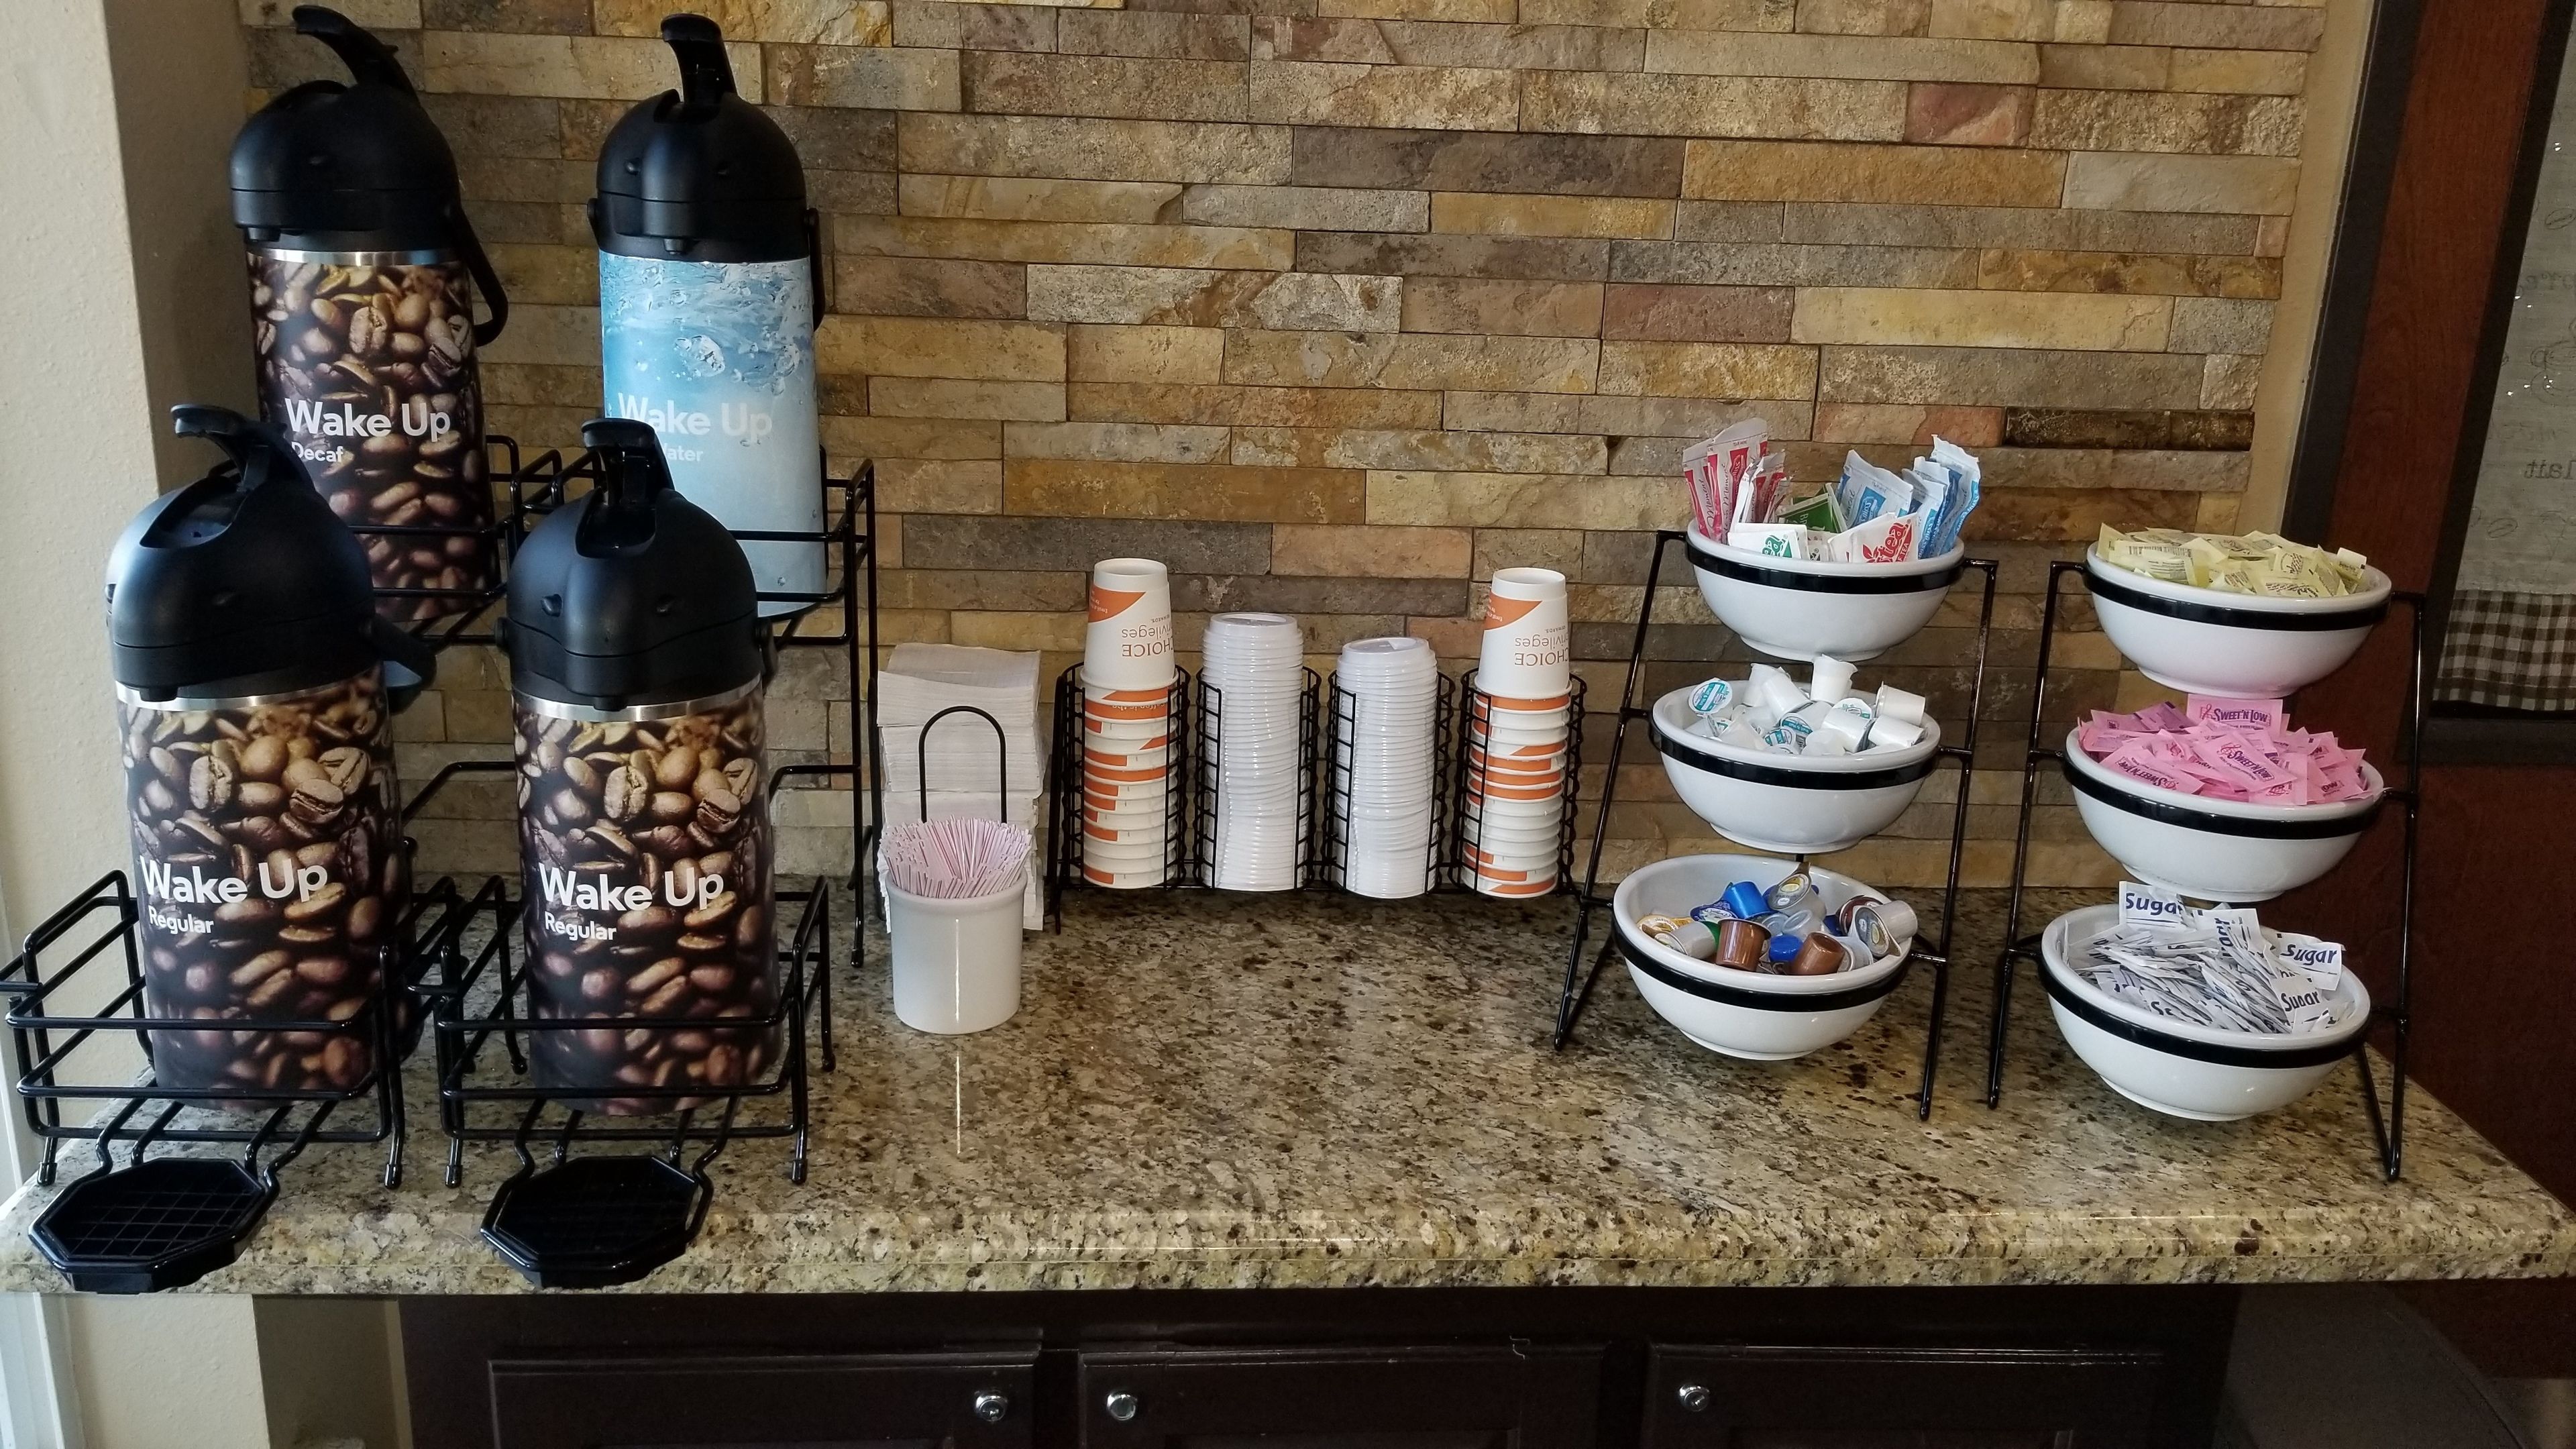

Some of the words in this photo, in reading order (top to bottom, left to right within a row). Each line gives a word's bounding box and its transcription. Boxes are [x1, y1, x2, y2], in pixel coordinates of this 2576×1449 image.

[284, 397, 392, 437] Wake
[402, 402, 451, 443] Up
[618, 392, 711, 436] Wake
[721, 402, 771, 444] Up
[290, 441, 343, 463] Decaf
[665, 443, 704, 462] ater
[1514, 632, 1569, 650] rivileges
[2213, 708, 2249, 722] SWEET'N
[2249, 709, 2269, 724] LOW
[139, 855, 248, 904] Wake
[258, 858, 328, 903] Up
[538, 862, 653, 912] Wake
[664, 867, 724, 910] Up
[148, 905, 214, 934] Regular
[544, 911, 617, 941] Regular
[2280, 944, 2338, 966] Sugar
